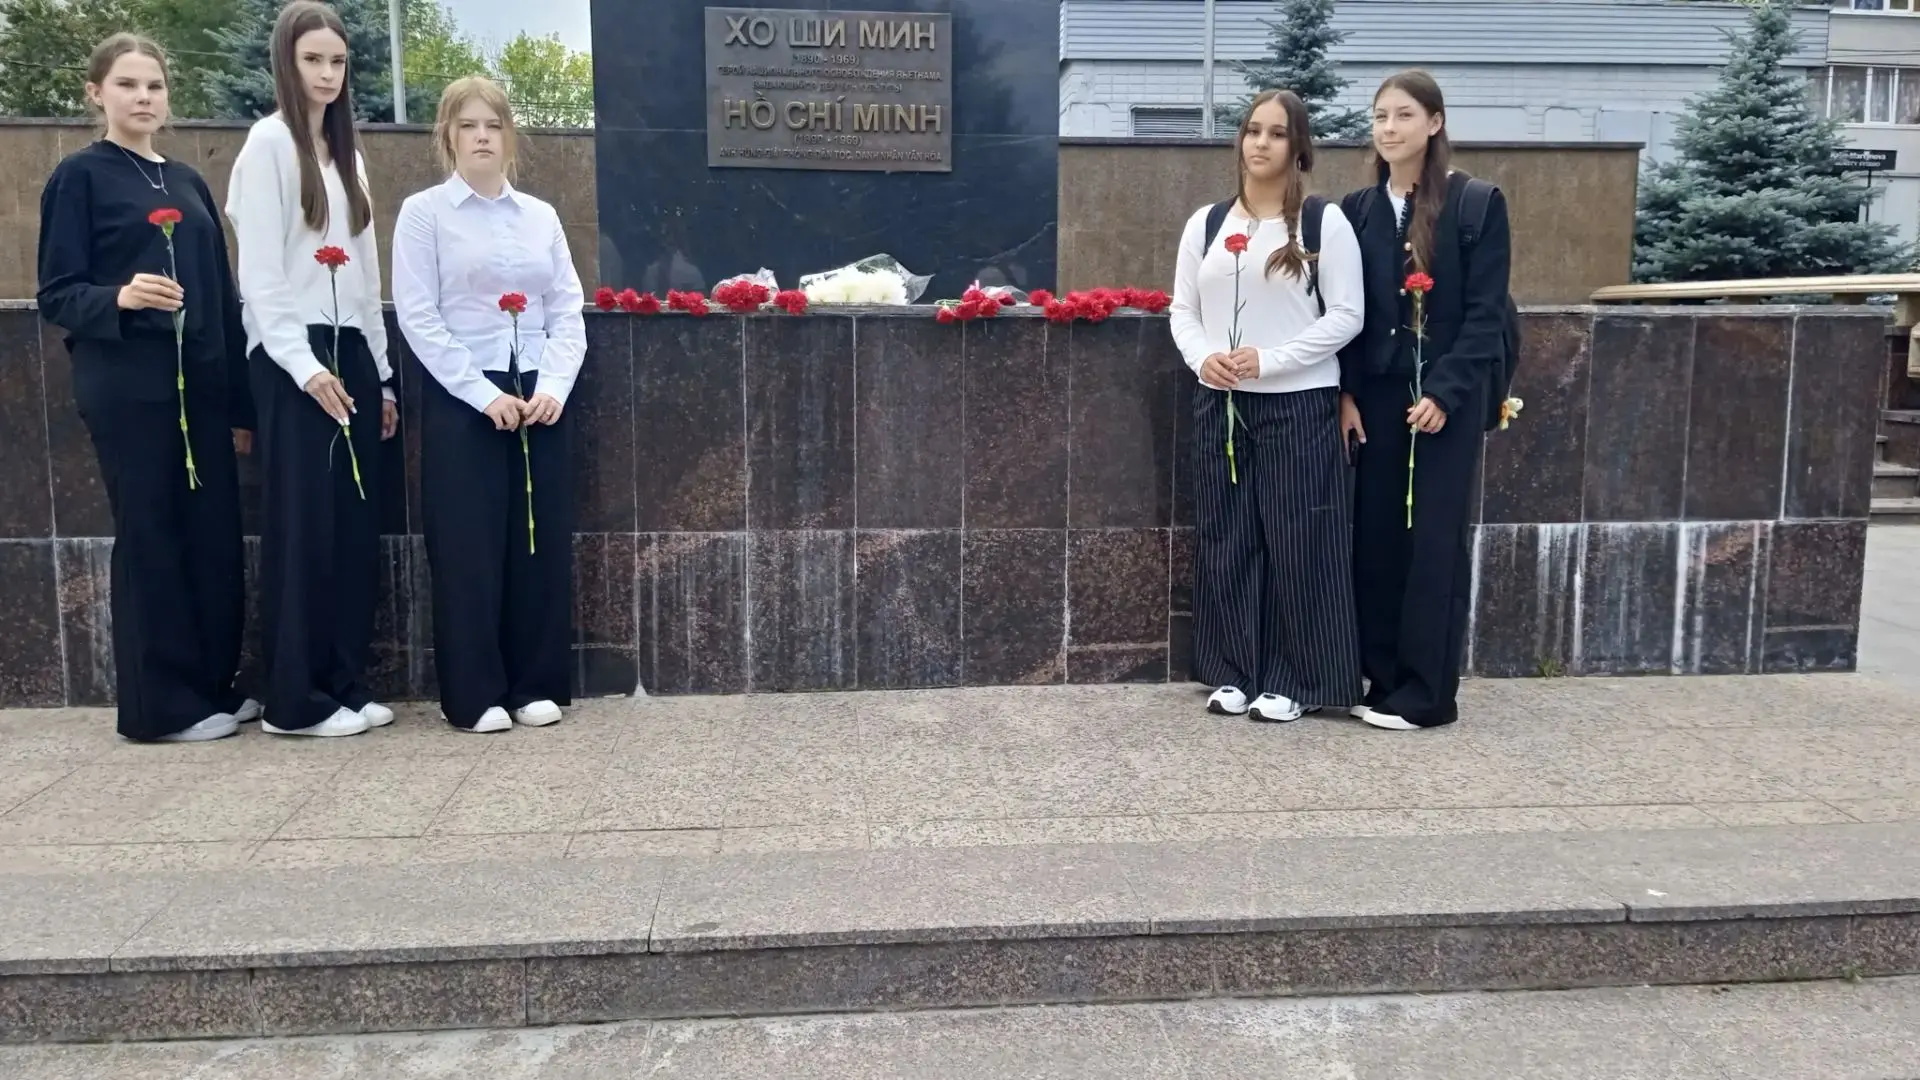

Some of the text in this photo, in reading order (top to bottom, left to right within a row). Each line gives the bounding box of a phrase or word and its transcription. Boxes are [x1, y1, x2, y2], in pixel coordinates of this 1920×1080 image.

[725, 16, 935, 50] ХО ШИ МИН
[831, 54, 860, 67] 1969)
[896, 71, 942, 82] ВЬЕТНАМА
[724, 91, 942, 134] HÒ CHÍ MINH
